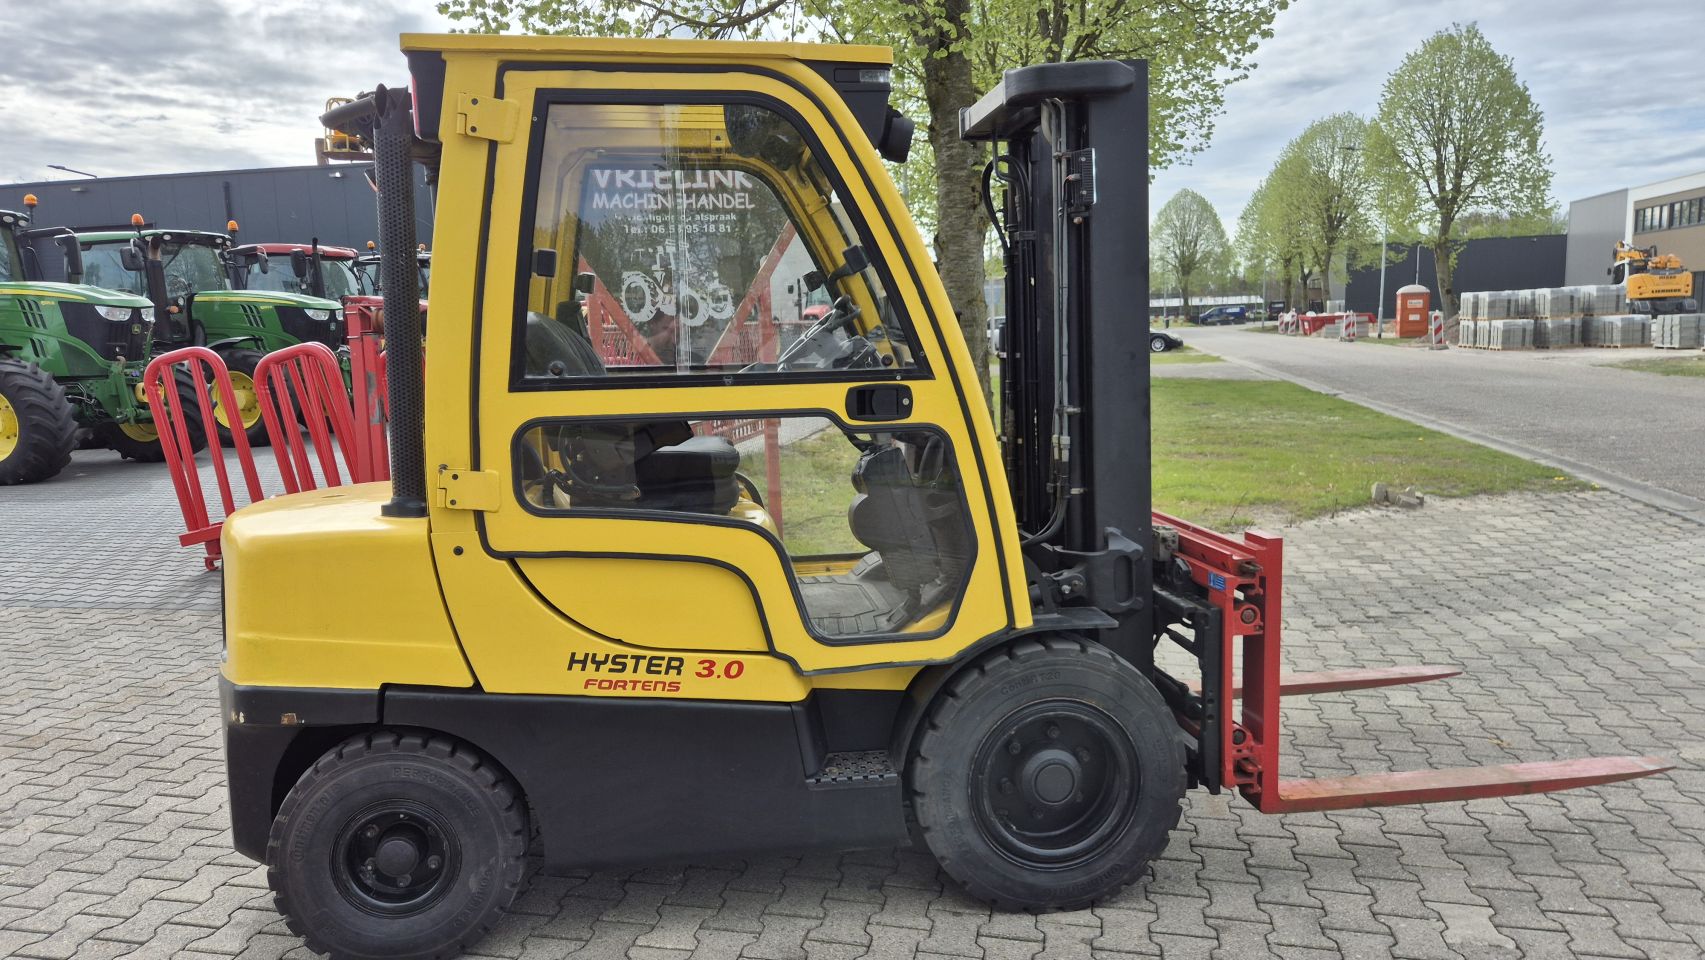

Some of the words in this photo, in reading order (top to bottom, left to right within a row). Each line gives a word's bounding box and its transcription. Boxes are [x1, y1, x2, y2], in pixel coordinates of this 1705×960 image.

[593, 170, 753, 189] VRIELINK
[592, 192, 756, 209] MACHINEHANDEL
[567, 652, 685, 676] HYSTER
[695, 659, 745, 679] 3.0
[583, 678, 682, 692] FORTENS
